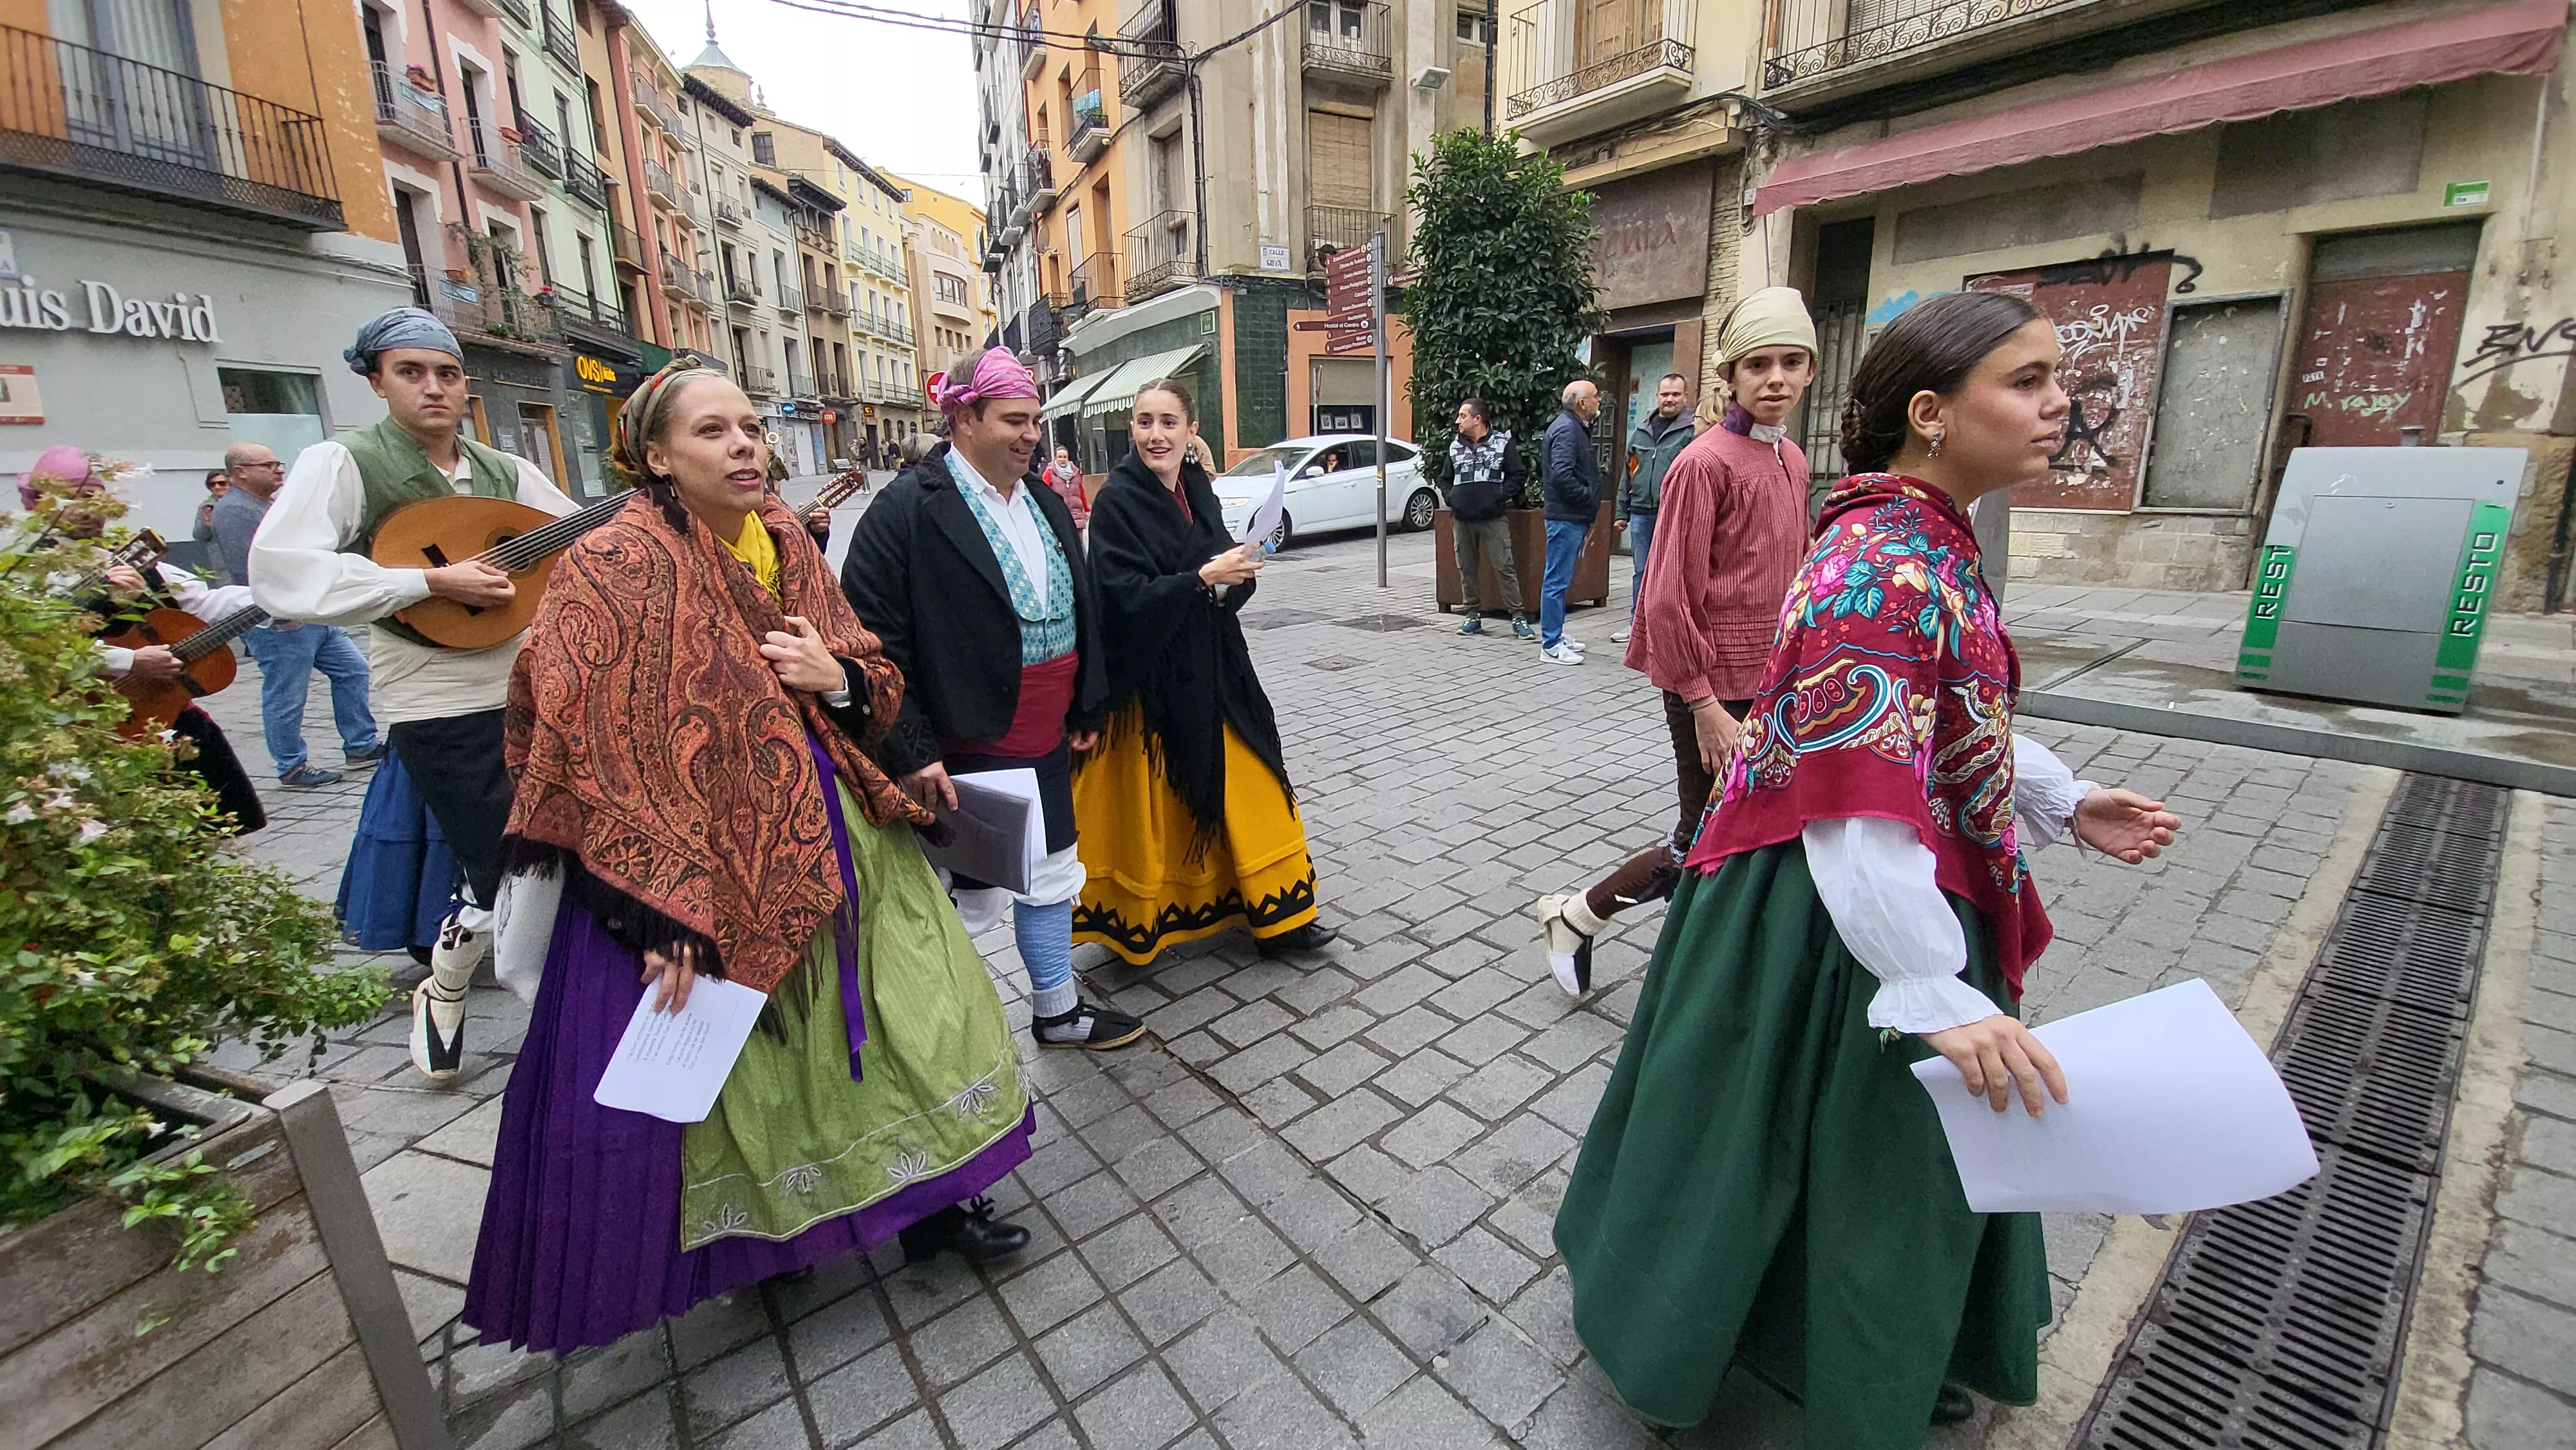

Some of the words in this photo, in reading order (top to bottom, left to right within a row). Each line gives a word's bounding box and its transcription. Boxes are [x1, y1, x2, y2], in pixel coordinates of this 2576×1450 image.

[1266, 259, 1282, 268] GOYA
[80, 279, 223, 343] David
[576, 355, 600, 382] OVS
[2450, 532, 2499, 637] RESTO
